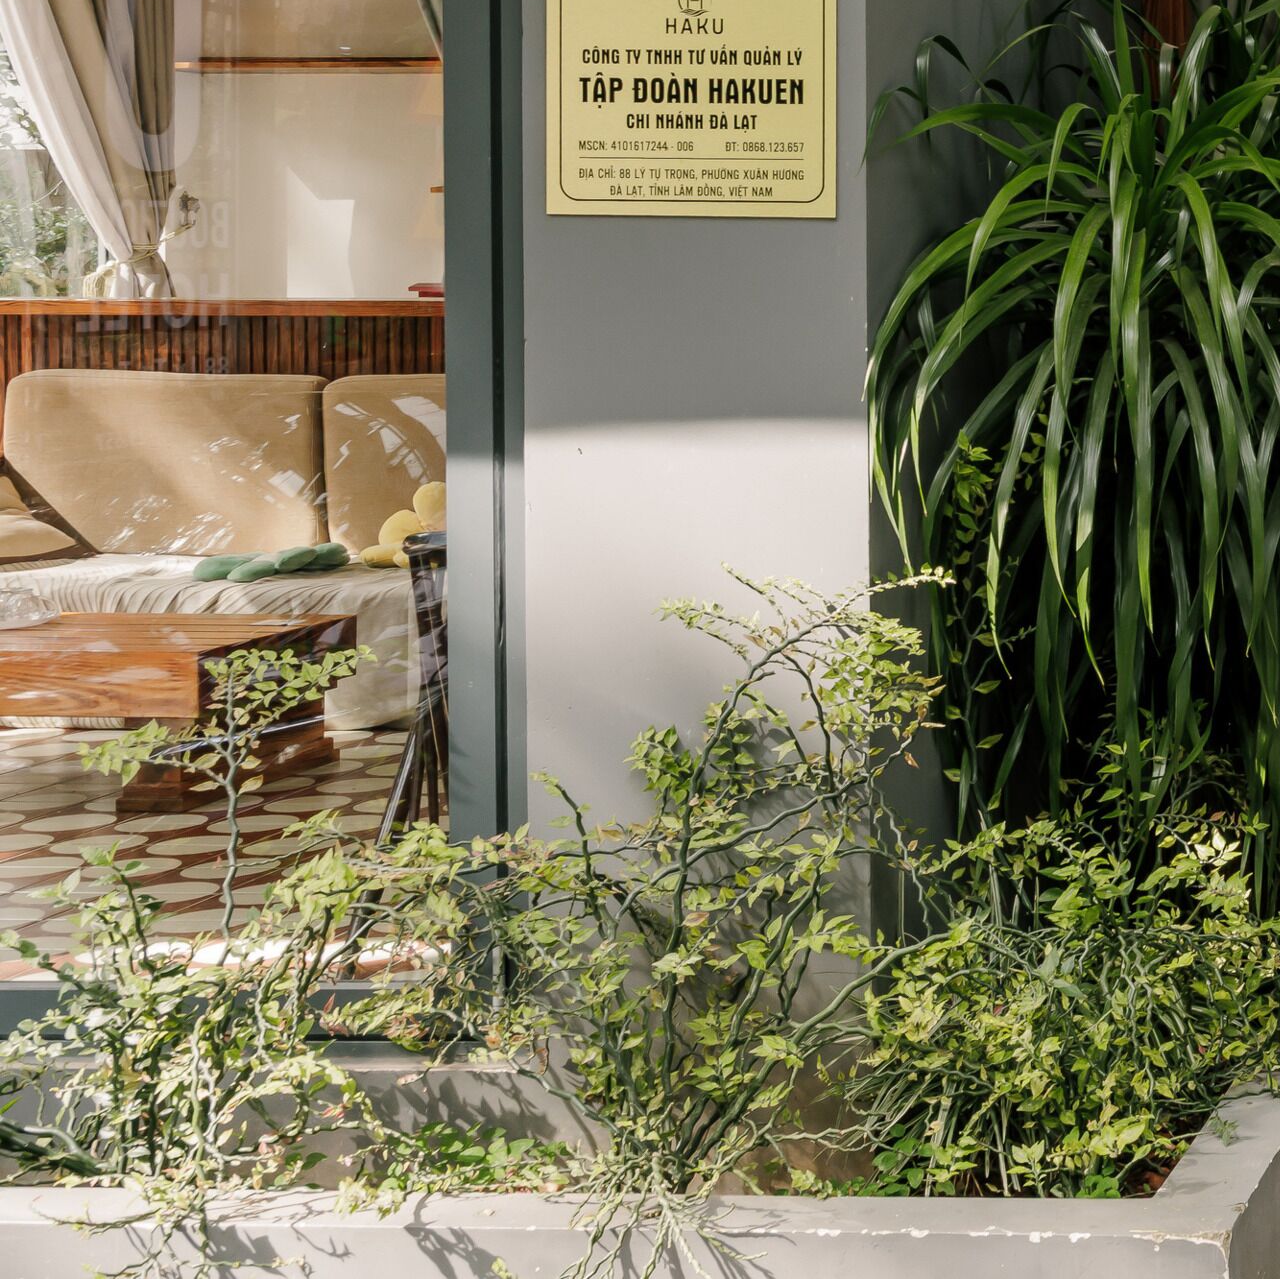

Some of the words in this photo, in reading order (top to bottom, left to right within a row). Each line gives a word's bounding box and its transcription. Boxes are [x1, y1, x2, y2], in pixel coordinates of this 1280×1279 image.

[665, 18, 724, 34] HAKU
[582, 45, 620, 64] CÔNG
[625, 49, 641, 64] TY
[646, 50, 682, 64] TNHH
[688, 48, 705, 65] TƯ
[743, 45, 781, 66] QUẢN
[787, 47, 802, 66] LÝ
[579, 72, 623, 109] TẬP
[632, 72, 698, 103] ĐOÀN
[709, 78, 804, 104] HAKUEN
[626, 114, 650, 129] CHI
[656, 111, 703, 129] NHÁNH
[709, 111, 728, 129] ĐÀ
[733, 114, 758, 133] LẠT
[578, 140, 608, 151] MSCN:
[677, 141, 694, 152] 006
[725, 141, 740, 152] ĐT:
[742, 141, 804, 153] 0868.123.657
[619, 168, 631, 179] 88
[752, 186, 773, 197] NAM
